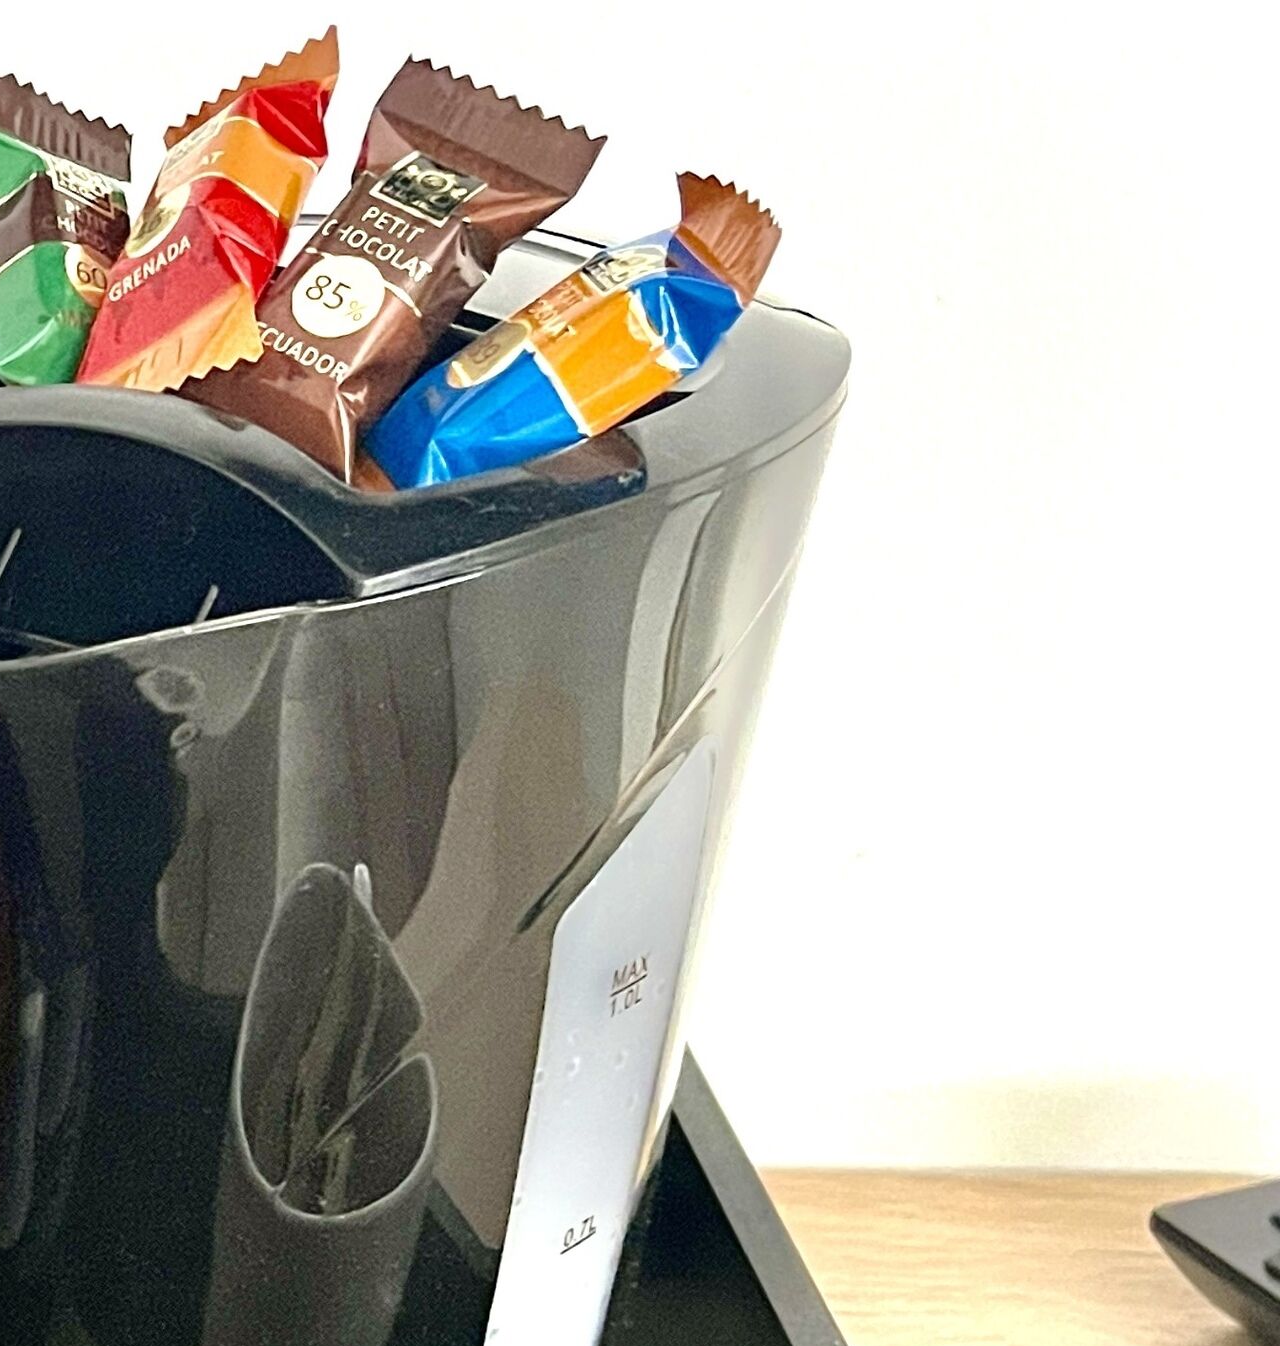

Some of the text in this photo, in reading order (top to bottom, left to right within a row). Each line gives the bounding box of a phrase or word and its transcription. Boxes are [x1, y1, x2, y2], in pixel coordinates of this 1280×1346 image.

[361, 206, 426, 243] PETIT
[107, 235, 191, 303] GRENADA
[321, 219, 433, 282] CHOCOLAT
[611, 952, 651, 990] MAX
